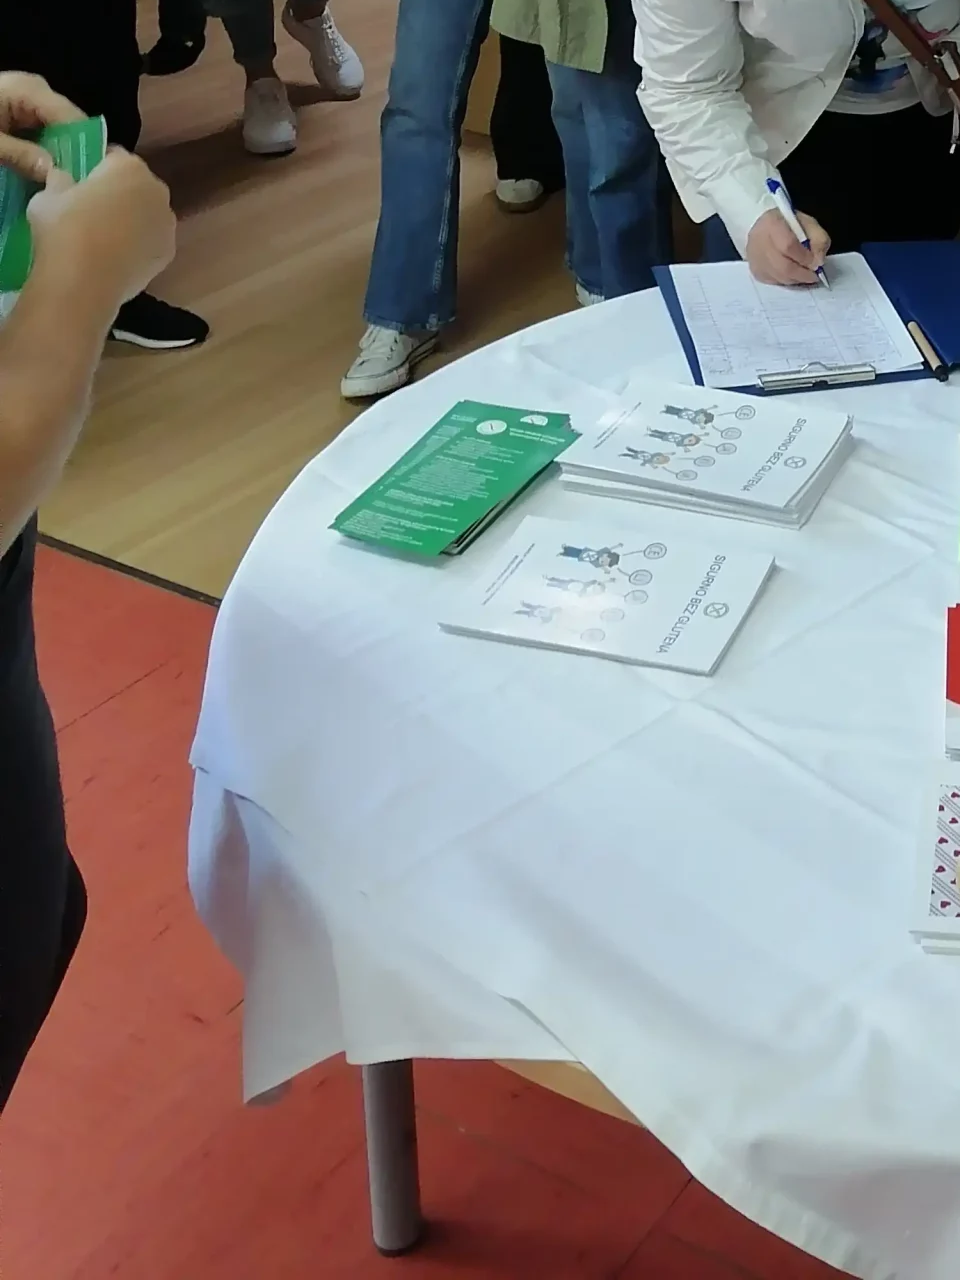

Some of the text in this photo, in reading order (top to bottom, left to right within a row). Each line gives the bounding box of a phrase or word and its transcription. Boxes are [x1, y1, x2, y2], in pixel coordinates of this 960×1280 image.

[740, 417, 808, 493] SIGURNO BEZ GLUTENA
[656, 554, 727, 654] SIGURNO BEZ GLUTENA
